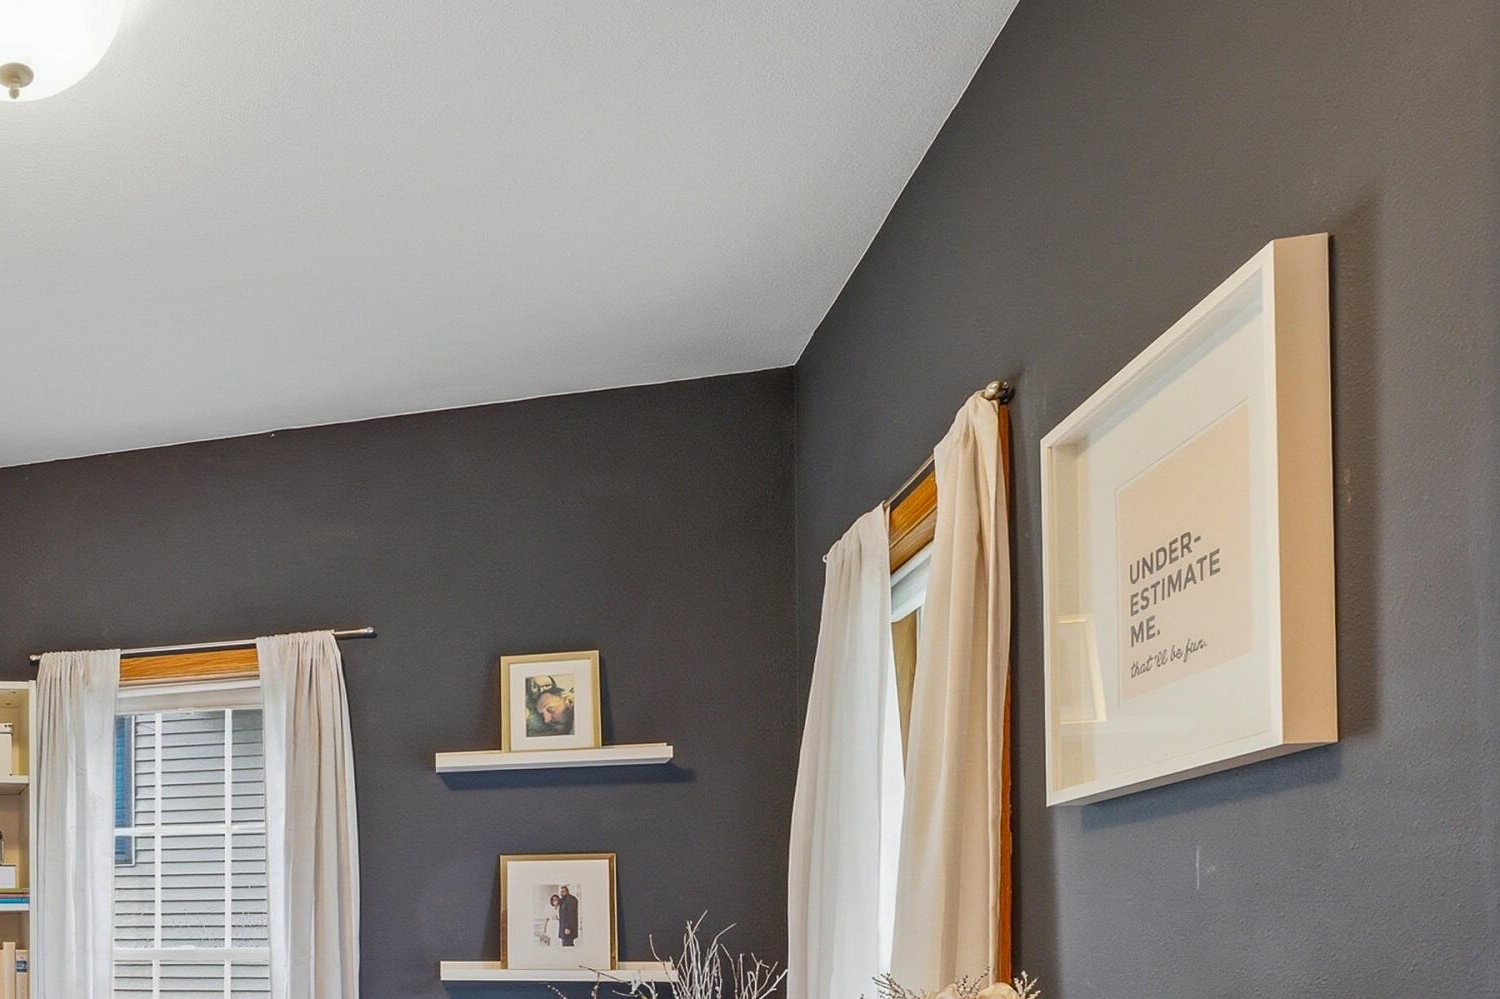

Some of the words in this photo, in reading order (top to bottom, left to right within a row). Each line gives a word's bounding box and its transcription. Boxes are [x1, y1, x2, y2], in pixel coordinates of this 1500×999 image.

[1129, 531, 1202, 585] UNDER-
[1130, 548, 1221, 617] ESTIMATE
[1169, 645, 1184, 662] be
